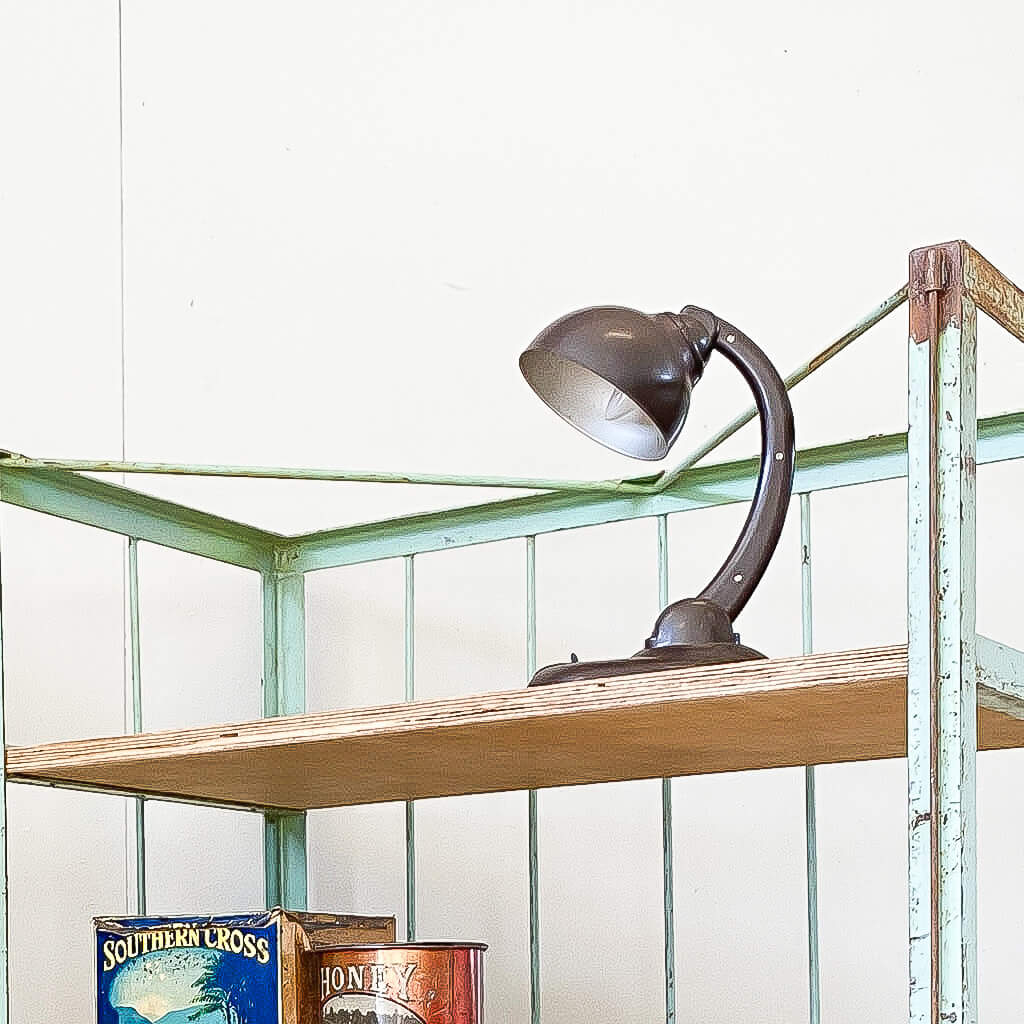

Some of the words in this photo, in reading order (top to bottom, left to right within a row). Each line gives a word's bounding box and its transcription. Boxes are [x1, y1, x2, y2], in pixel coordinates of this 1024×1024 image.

[103, 926, 200, 971] SOUTHERN
[204, 927, 270, 964] CROSS
[320, 962, 417, 1001] HONEY
